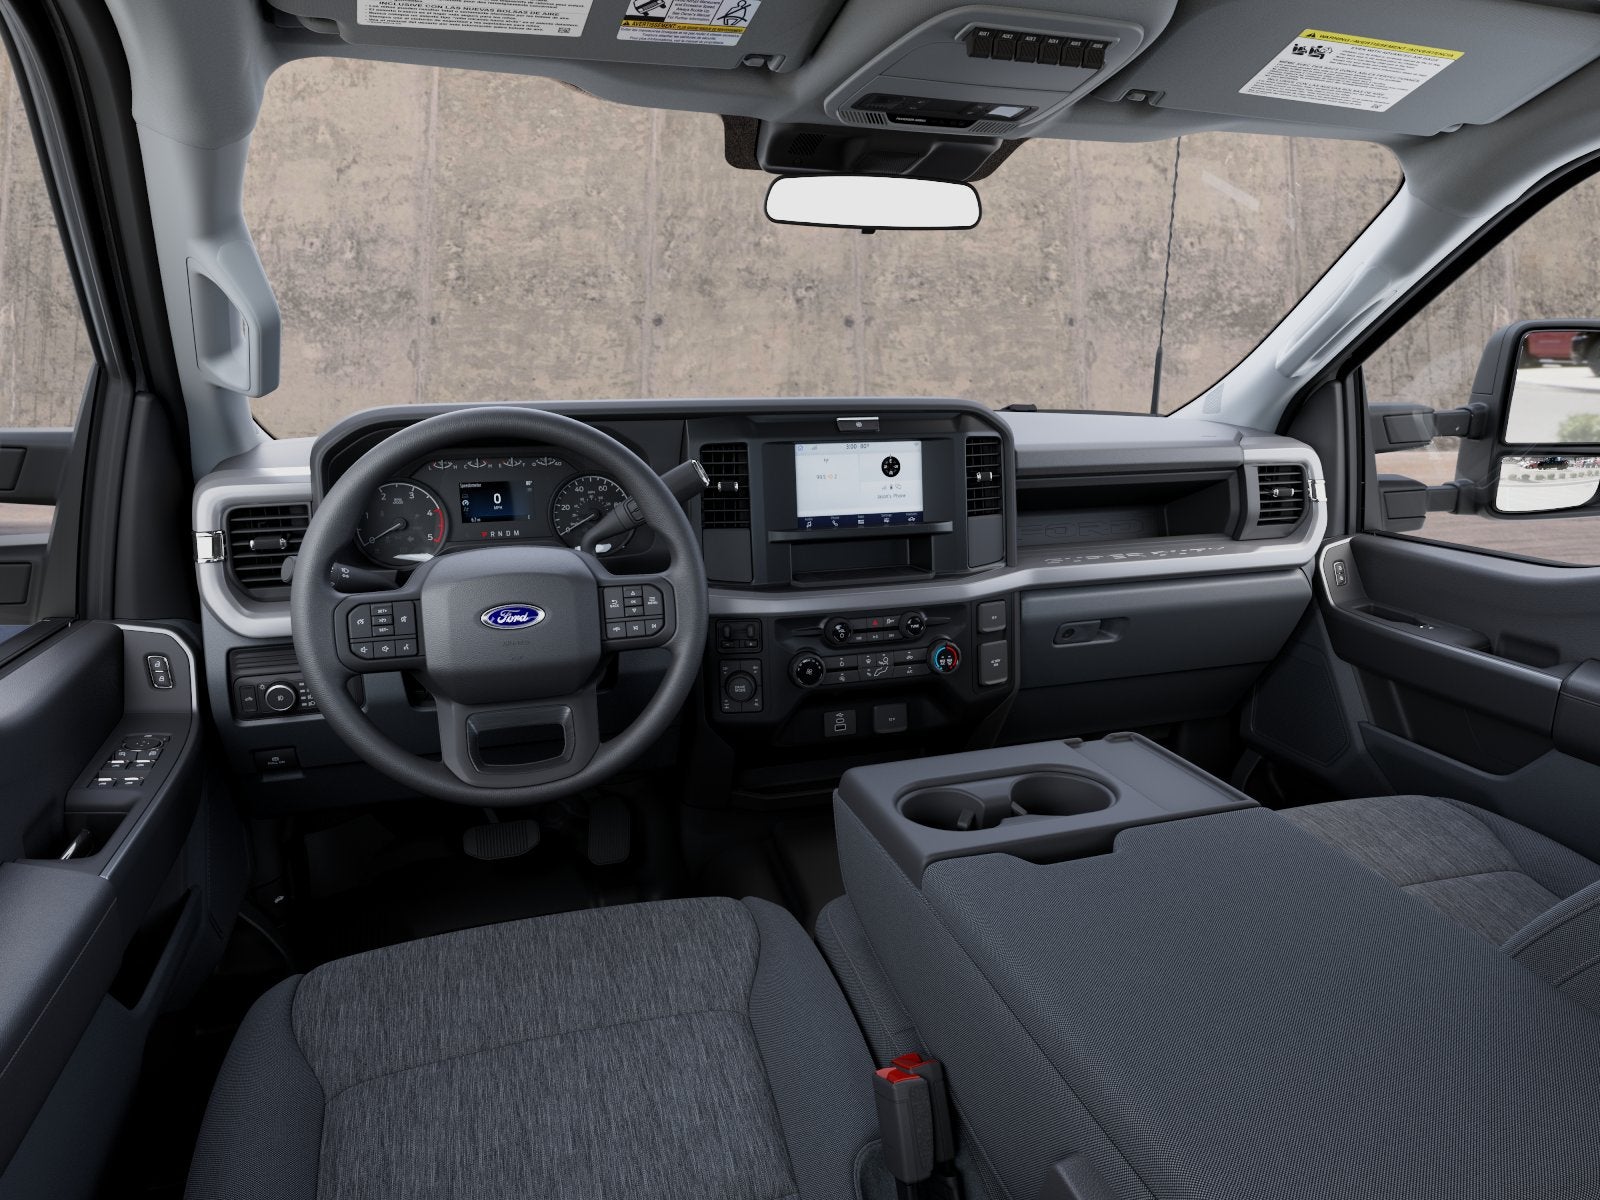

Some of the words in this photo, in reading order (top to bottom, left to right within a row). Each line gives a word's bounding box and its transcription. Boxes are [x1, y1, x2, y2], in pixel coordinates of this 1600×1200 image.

[574, 485, 585, 493] 40
[381, 492, 387, 501] 2
[408, 491, 415, 499] 3
[493, 492, 502, 505] 0
[426, 509, 433, 517] 4
[427, 533, 434, 541] 5
[513, 529, 520, 537] M
[497, 608, 532, 624] Ford
